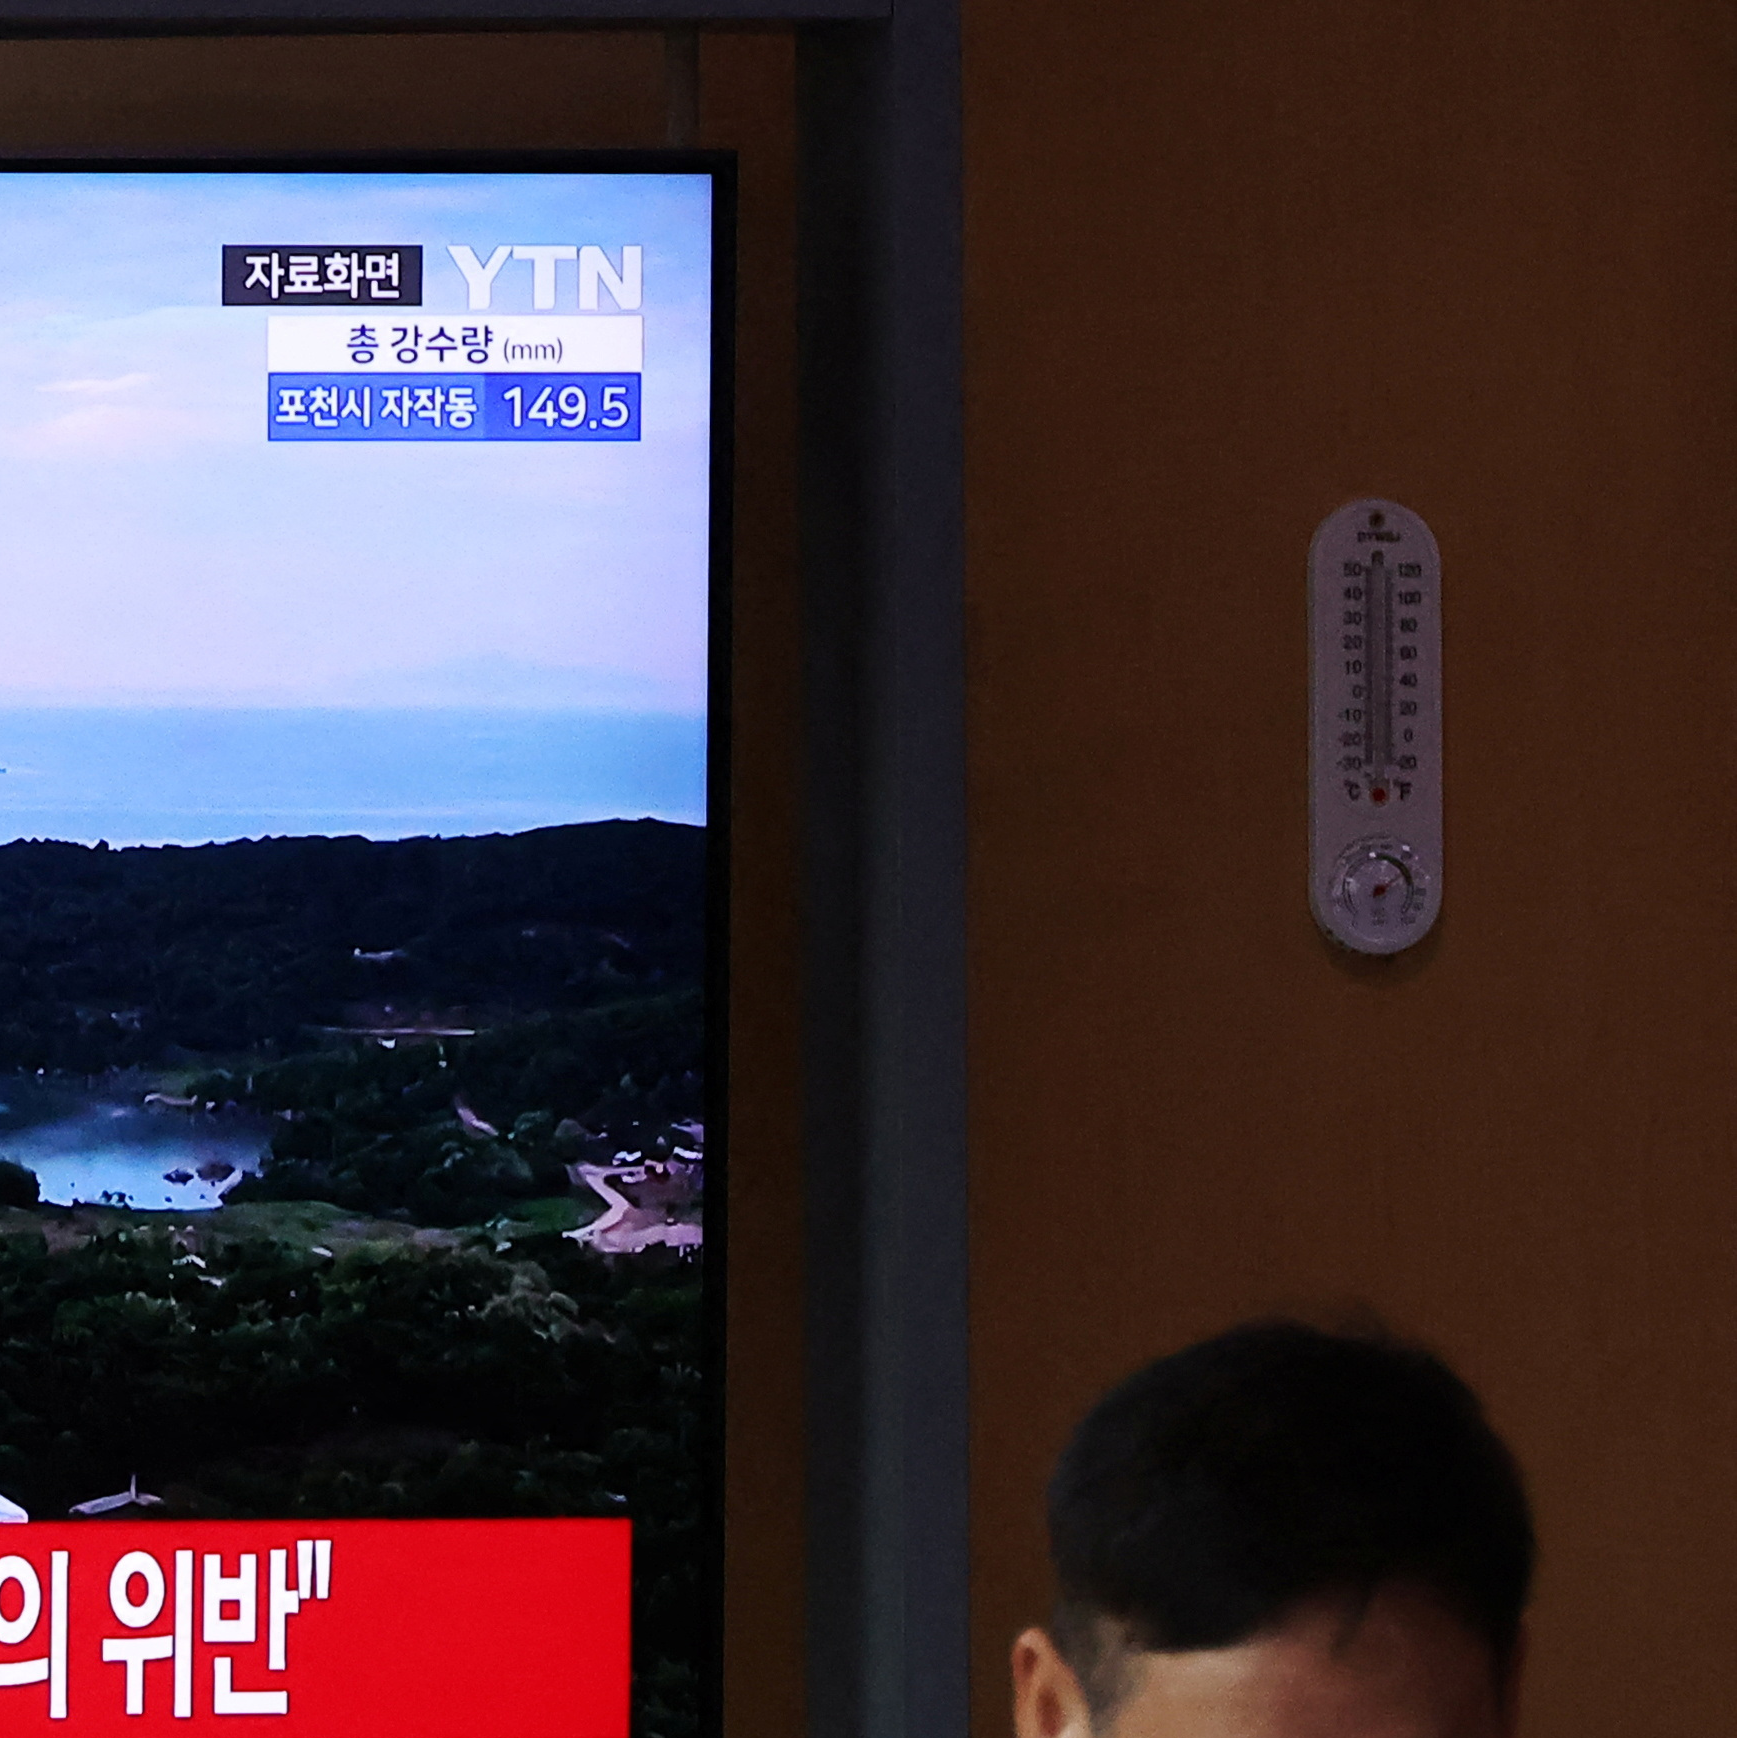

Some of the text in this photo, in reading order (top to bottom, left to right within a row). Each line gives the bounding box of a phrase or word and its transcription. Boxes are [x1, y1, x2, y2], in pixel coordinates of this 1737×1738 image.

[246, 253, 399, 298] 자료화면
[446, 244, 643, 311] YTN
[347, 325, 565, 364] 총 강수량 (mm)
[276, 386, 628, 430] 포천시 자작동 149.5
[1345, 660, 1362, 674] 10
